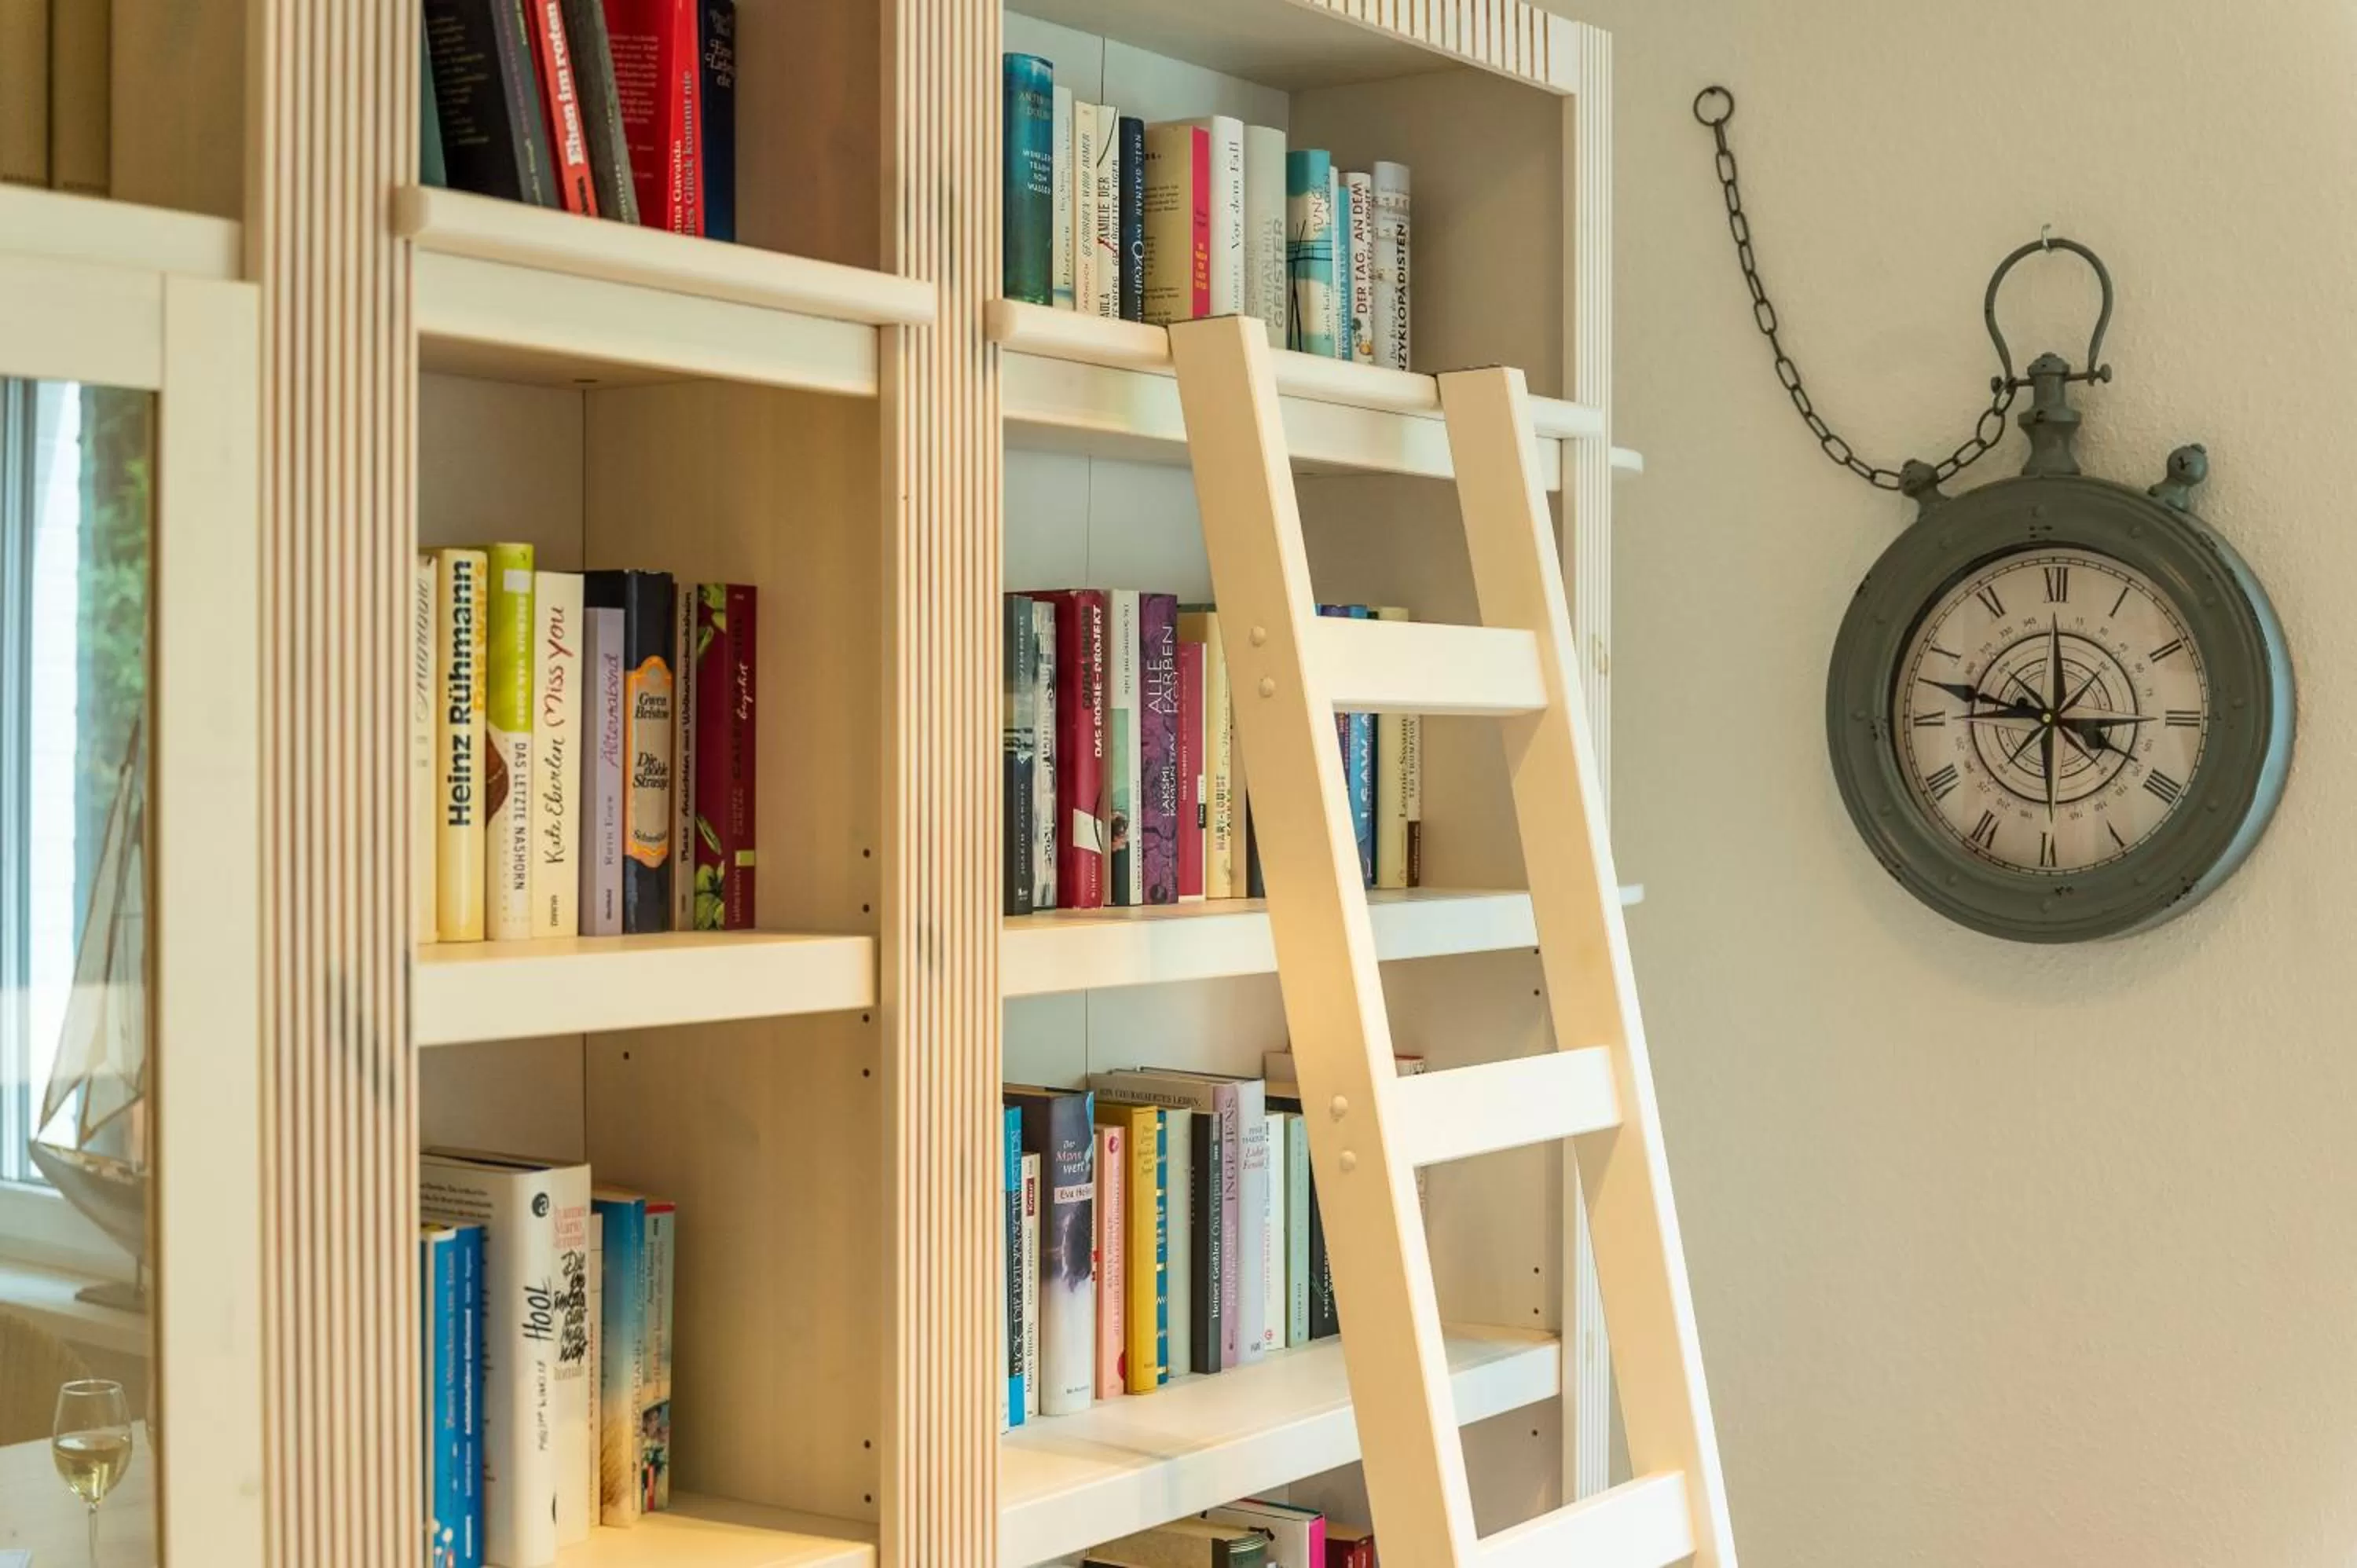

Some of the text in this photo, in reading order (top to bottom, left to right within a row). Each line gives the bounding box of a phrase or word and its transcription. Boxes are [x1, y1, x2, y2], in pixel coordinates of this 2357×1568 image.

[683, 99, 693, 155] kommt
[673, 140, 682, 203] Gavalda
[683, 159, 695, 204] Glück
[1352, 182, 1363, 215] DEM
[1353, 219, 1364, 243] AN
[1274, 218, 1284, 329] GEISTER
[1356, 287, 1367, 314] DER
[1395, 223, 1407, 370] NZYKLOPÄDISTEN
[1099, 293, 1109, 318] AULA
[546, 606, 574, 658] you
[447, 560, 471, 826] Heinz Rühmann
[544, 665, 565, 727] Miss
[1093, 604, 1102, 758] DAS ROSIE-PROJEKT
[1147, 659, 1163, 714] ALLE
[1162, 625, 1174, 713] FARBEN
[2165, 710, 2200, 727] III
[1360, 738, 1369, 803] SAW
[514, 742, 526, 891] DAS LETZTE NASHORN
[1225, 1097, 1236, 1202] INGE JENS
[522, 1280, 552, 1341] HOOL
